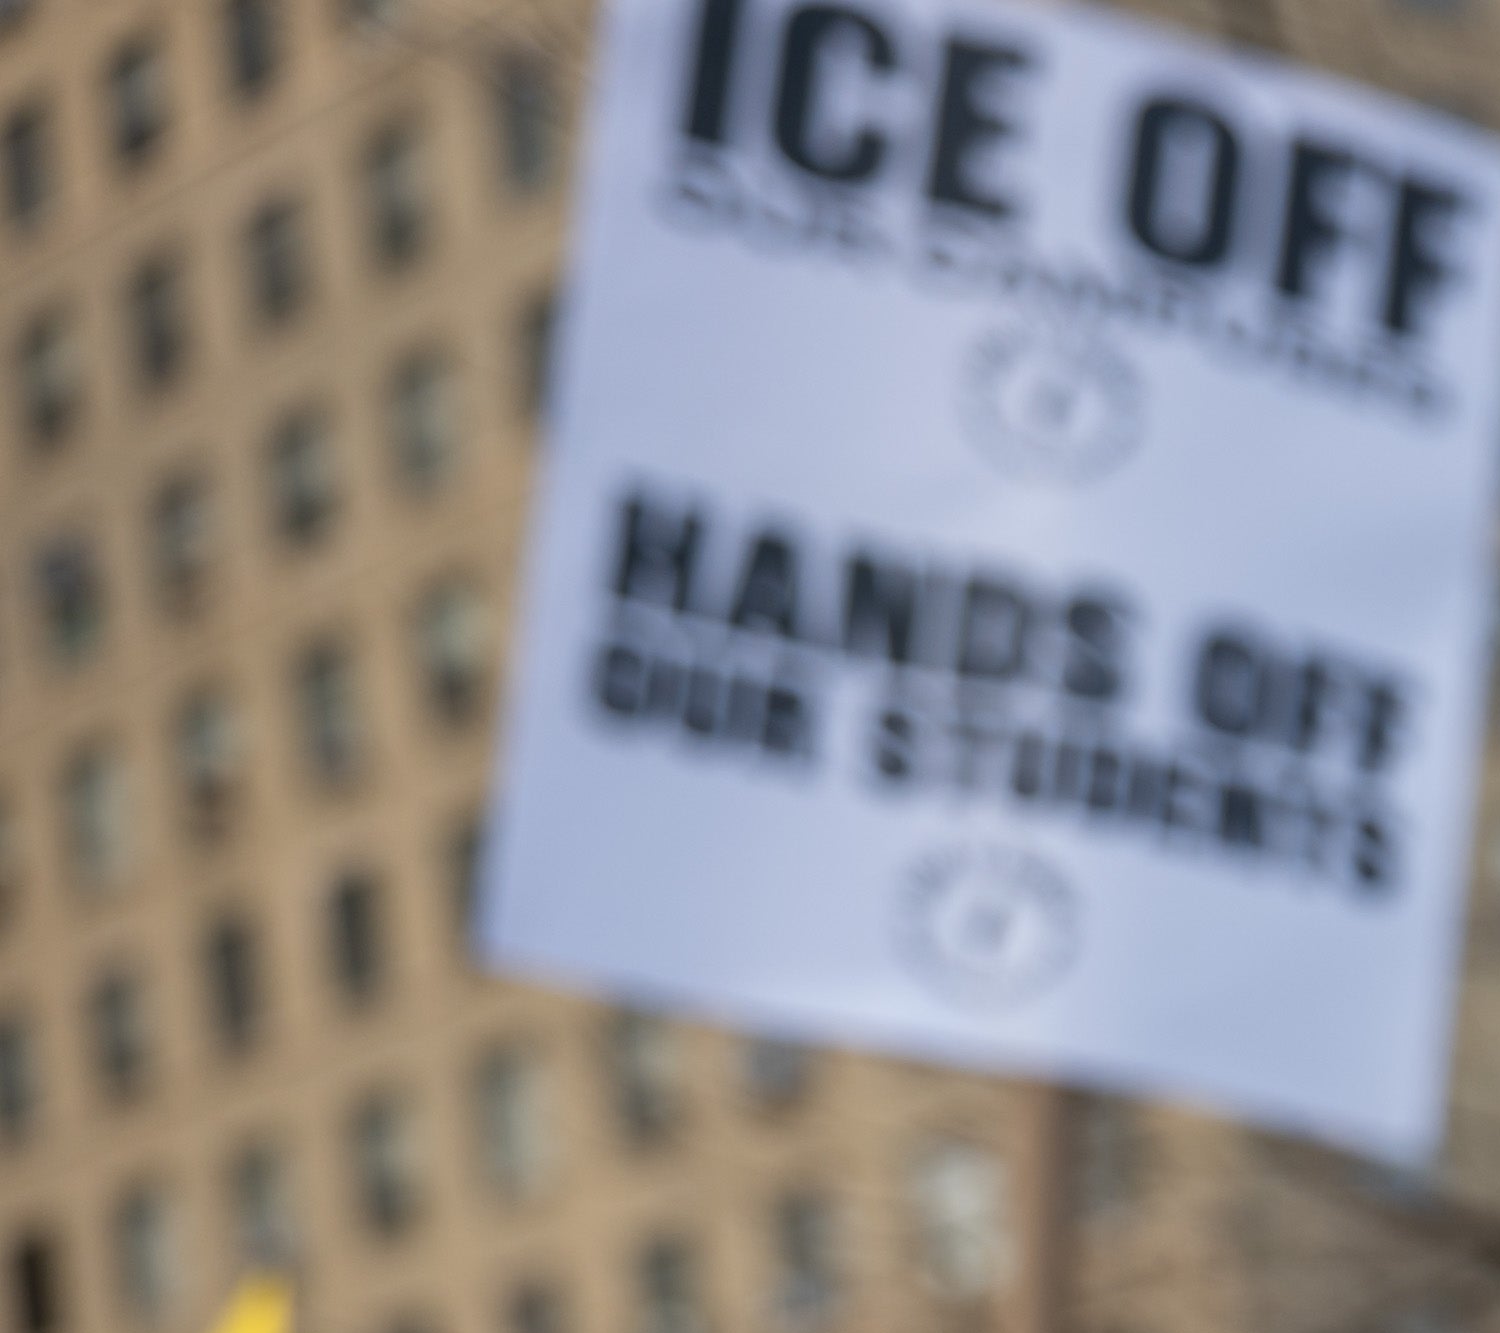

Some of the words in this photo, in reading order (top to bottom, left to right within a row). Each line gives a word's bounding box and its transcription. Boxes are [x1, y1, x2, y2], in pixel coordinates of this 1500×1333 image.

[678, 0, 1035, 222] ICE
[1120, 85, 1484, 342] OFF
[608, 482, 1138, 706] HANDS
[1198, 626, 1420, 778] OFF
[872, 706, 1402, 892] STUDENTS
